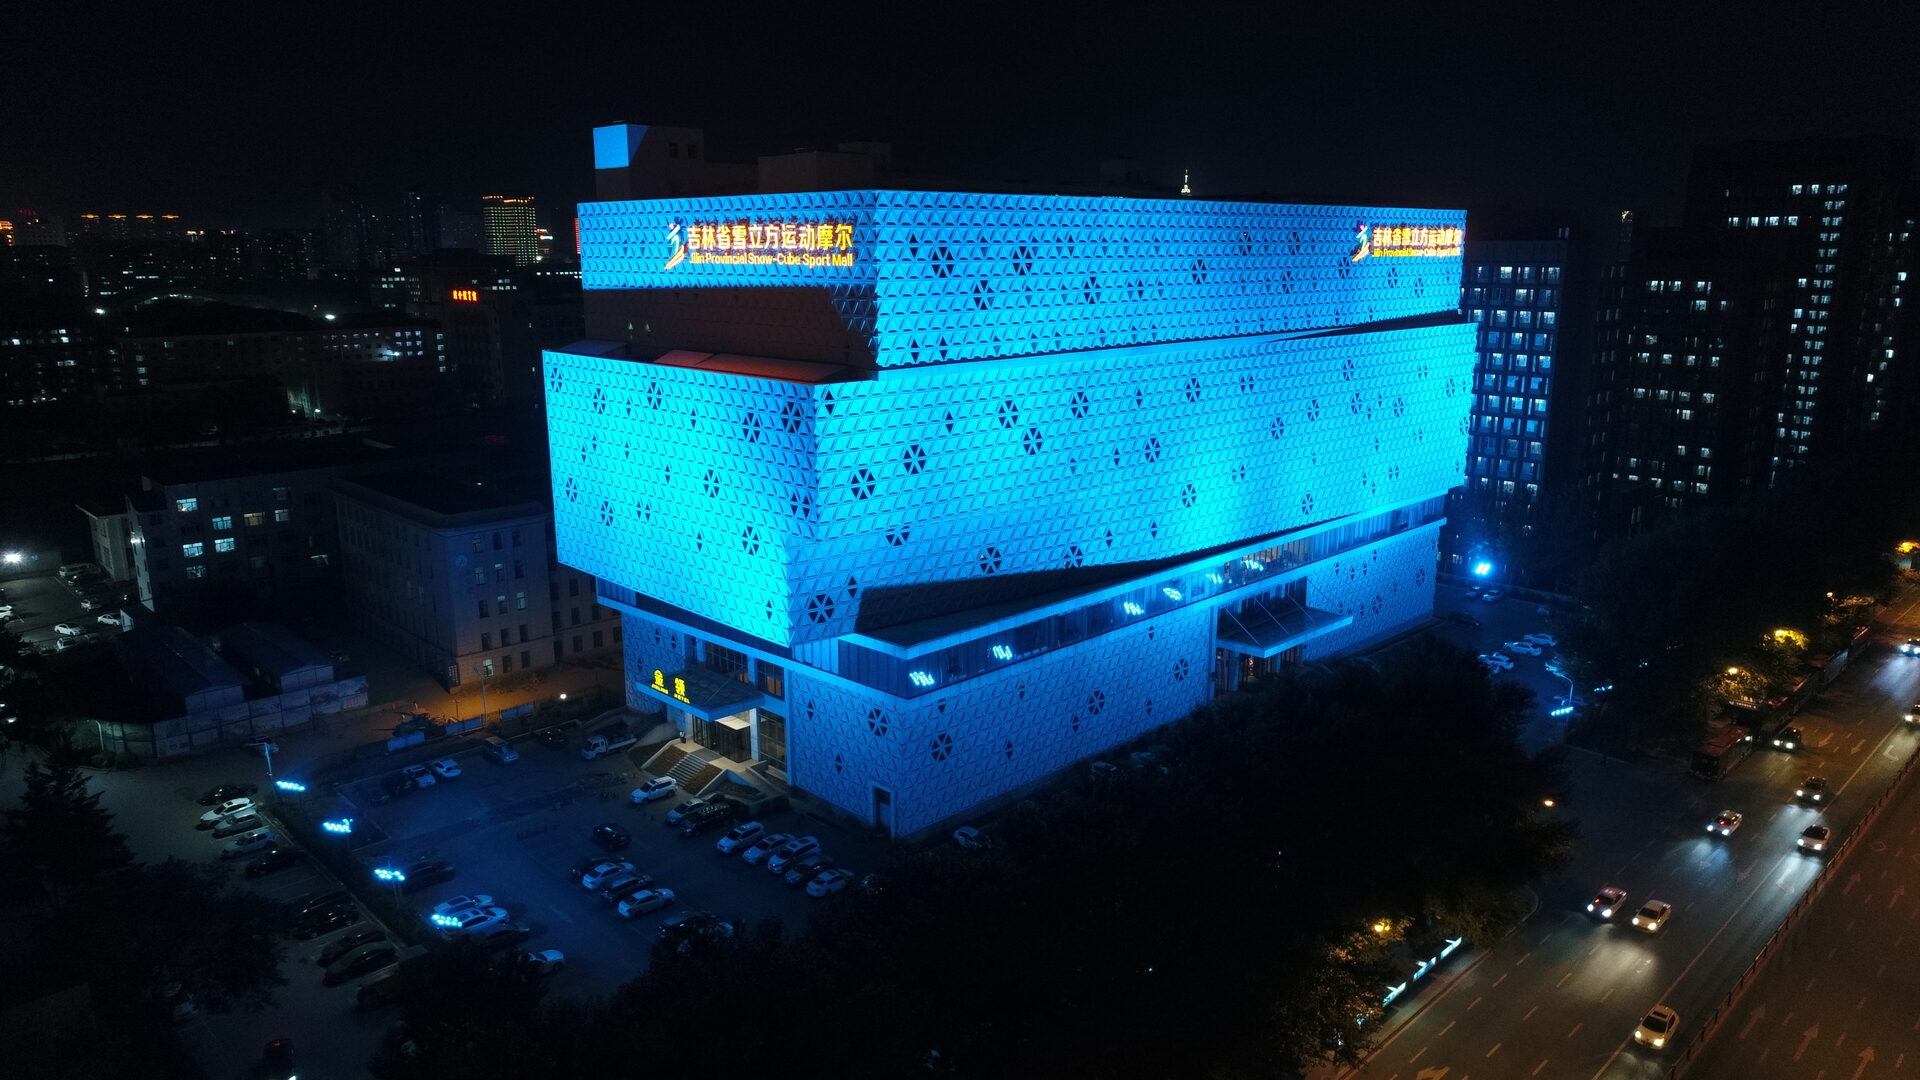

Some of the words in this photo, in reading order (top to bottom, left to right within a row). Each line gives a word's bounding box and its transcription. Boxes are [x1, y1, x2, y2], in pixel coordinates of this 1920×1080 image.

[687, 224, 854, 250] 吉林省雪立方运动摩尔
[706, 252, 747, 264] Provincial
[748, 252, 800, 265] Snow-Cube
[802, 253, 831, 268] Sport
[832, 253, 853, 266] Mall
